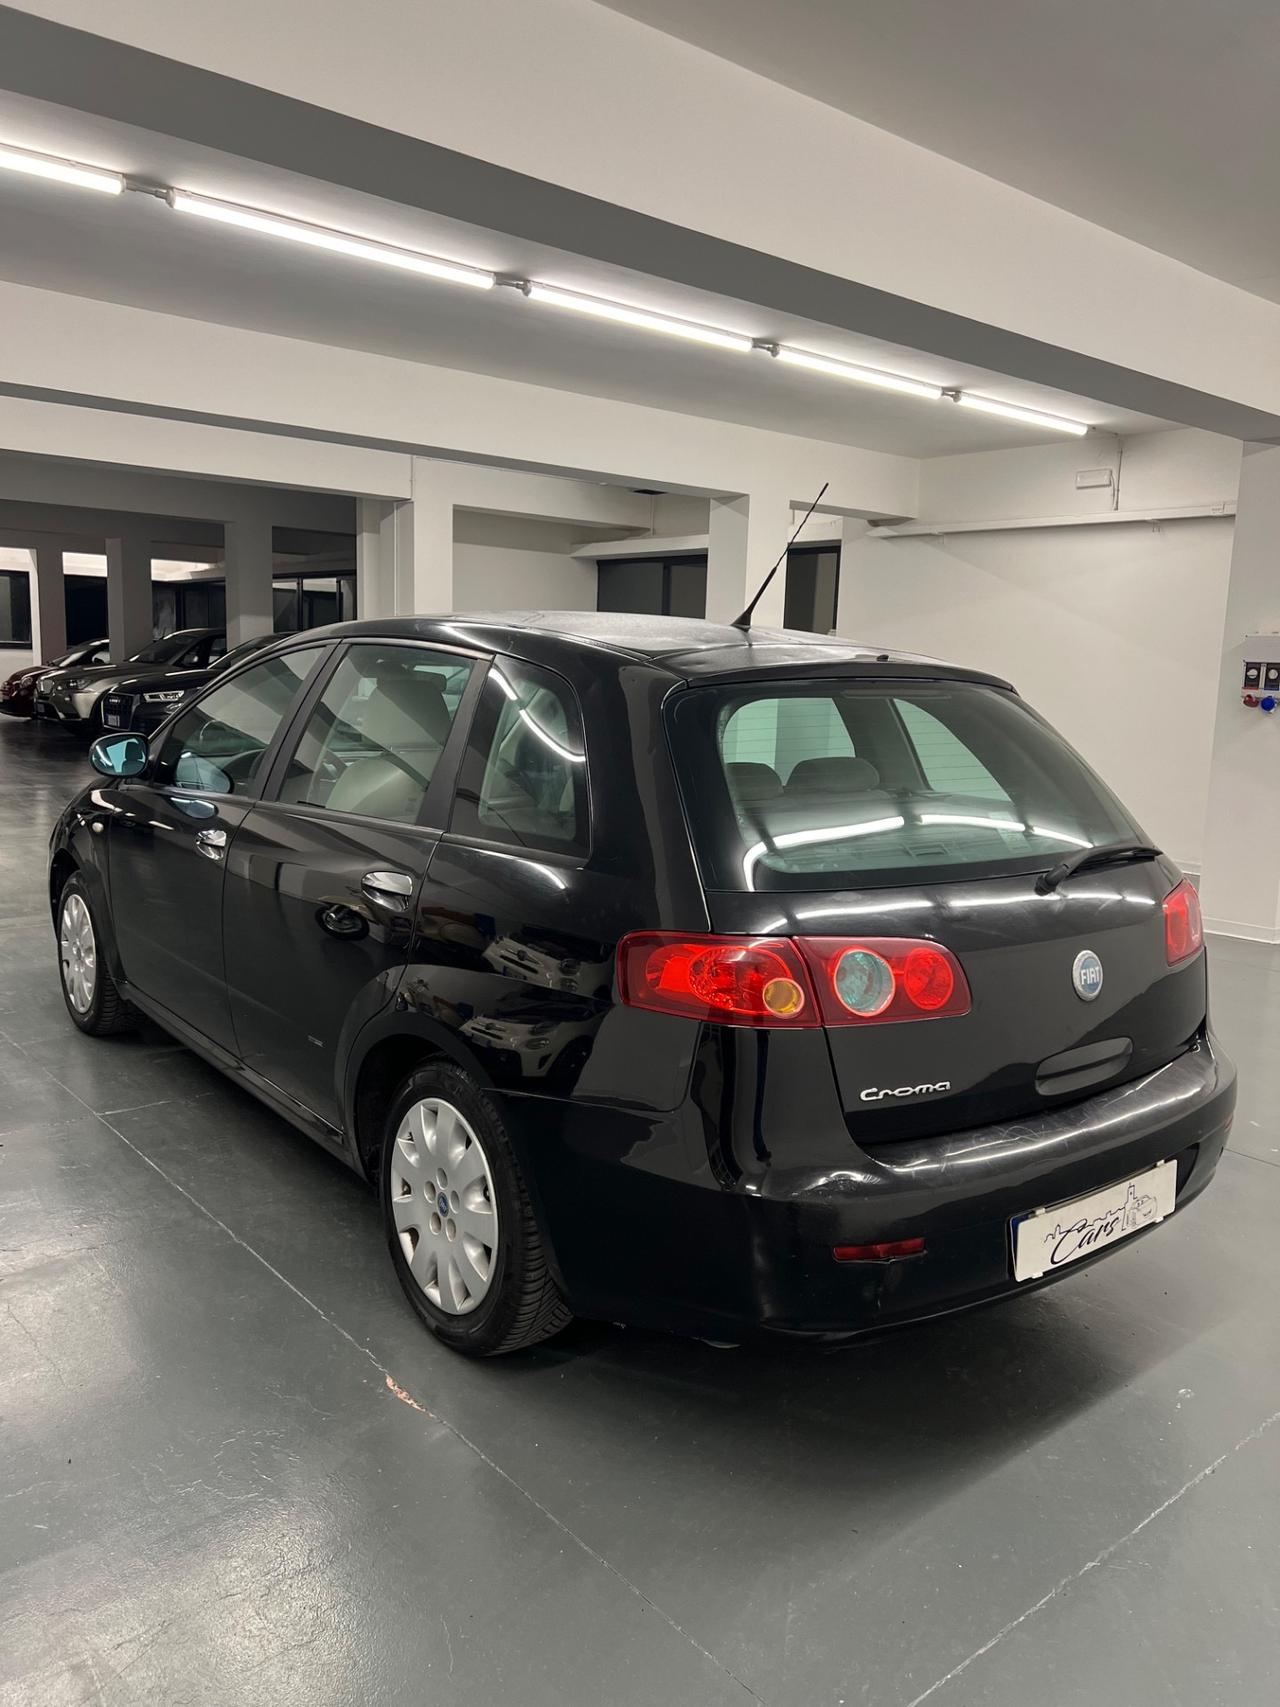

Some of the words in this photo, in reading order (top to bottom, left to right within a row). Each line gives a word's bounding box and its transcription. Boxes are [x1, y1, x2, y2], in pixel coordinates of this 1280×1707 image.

[1080, 966, 1100, 985] FIAT
[860, 1081, 951, 1101] Croma
[1050, 1217, 1120, 1265] Cars
